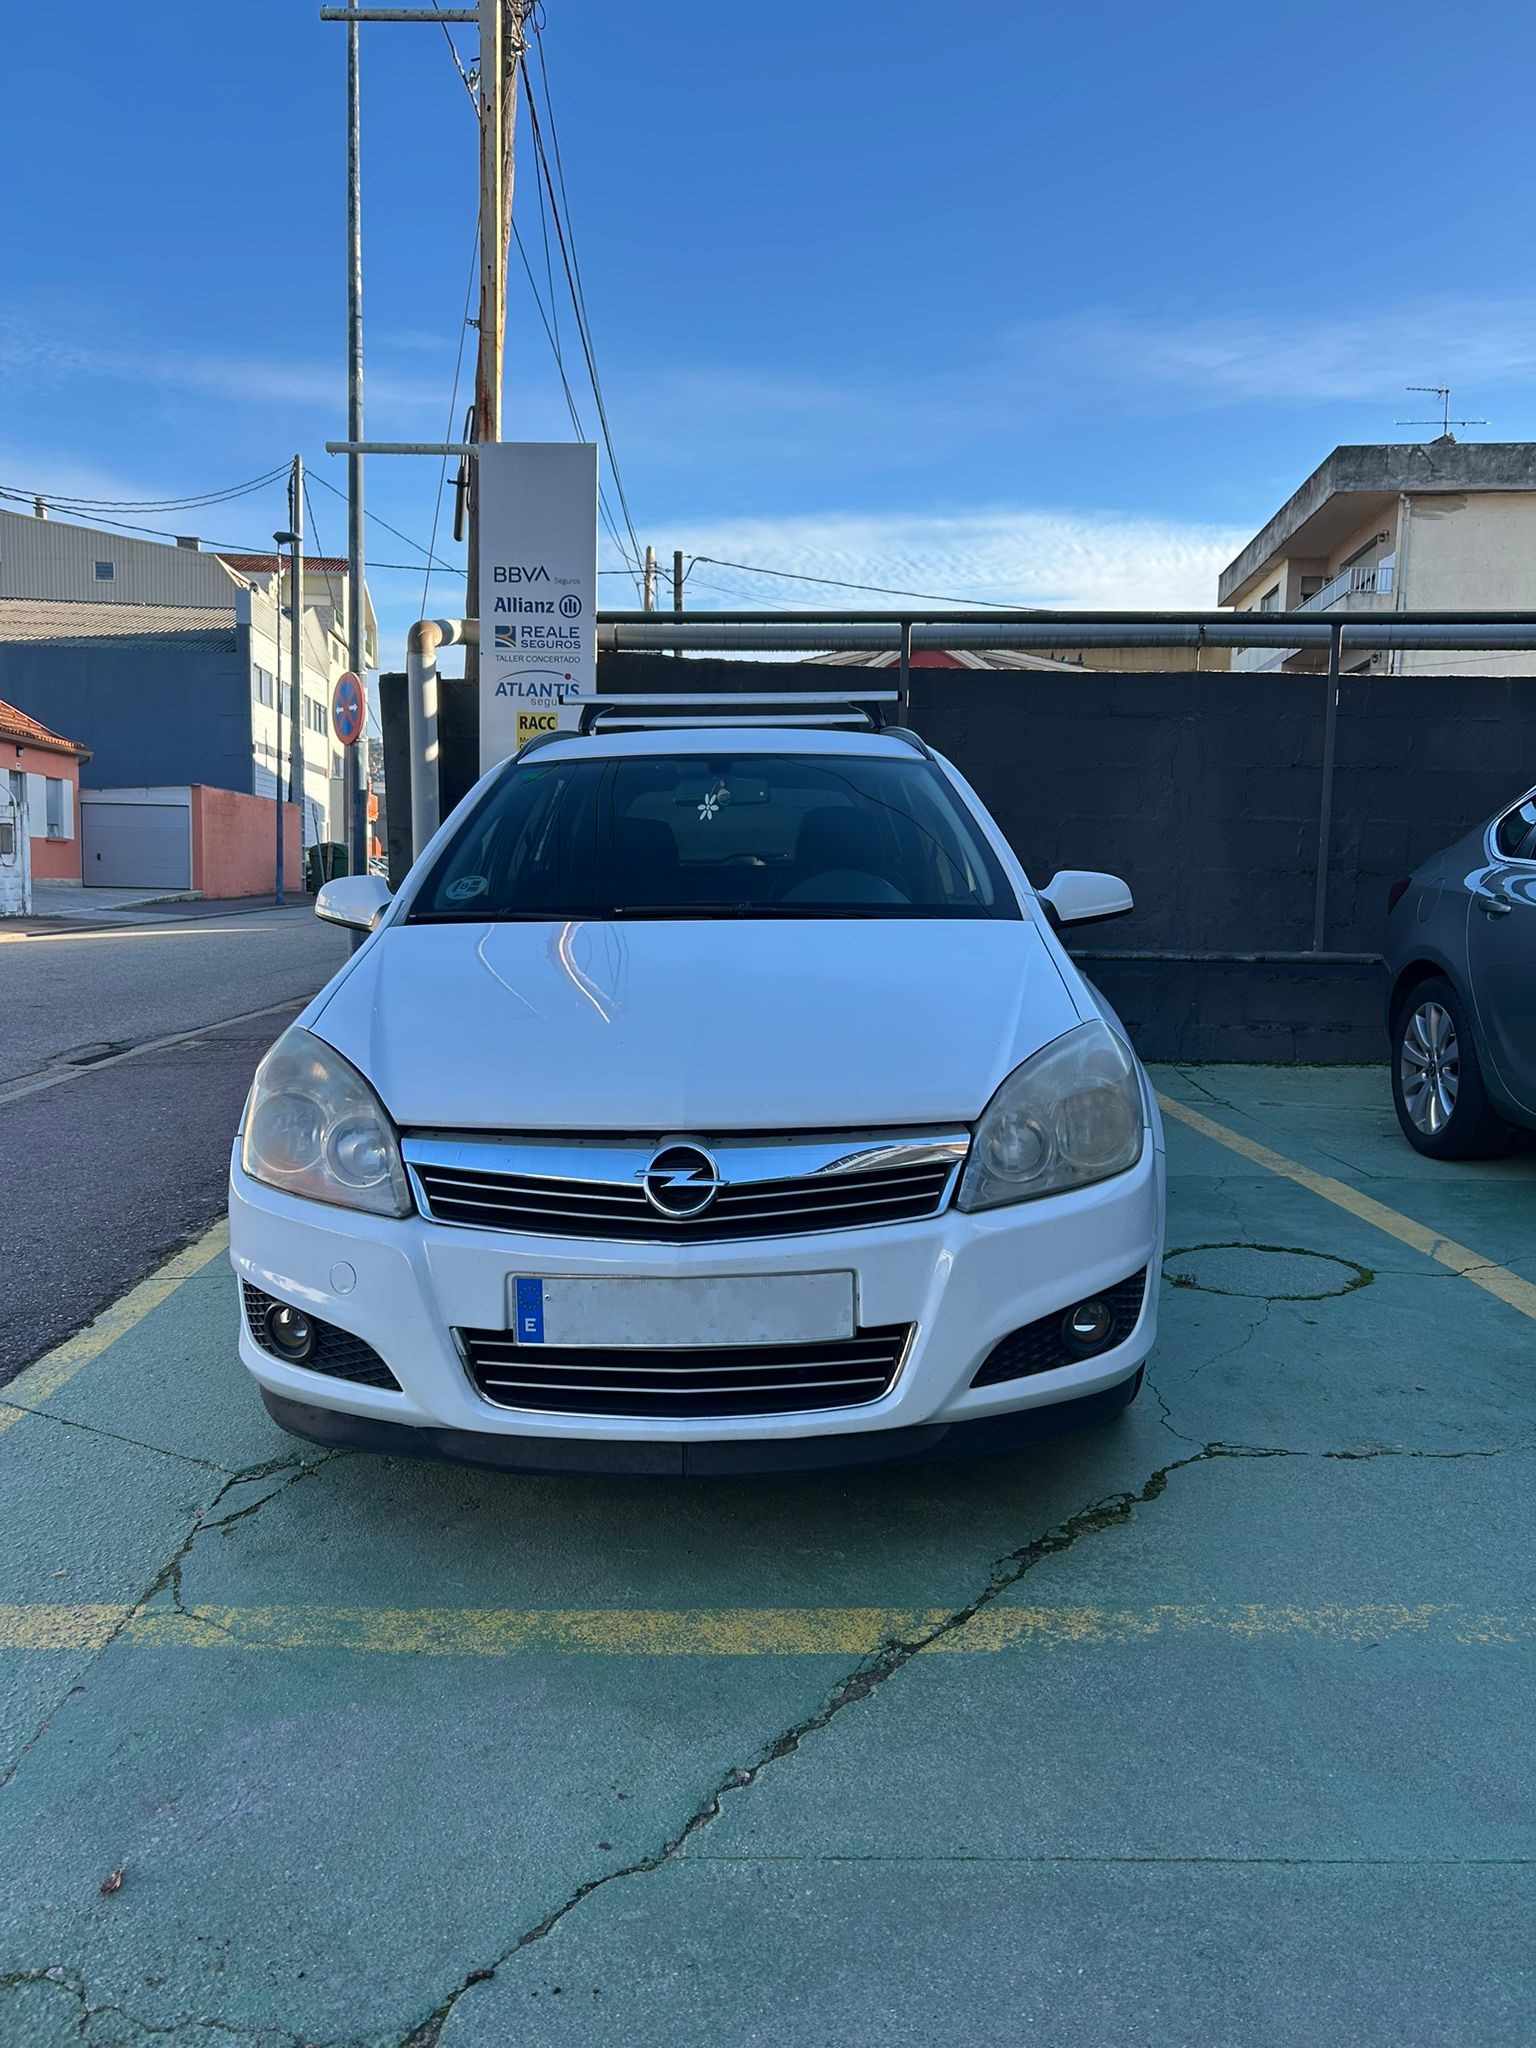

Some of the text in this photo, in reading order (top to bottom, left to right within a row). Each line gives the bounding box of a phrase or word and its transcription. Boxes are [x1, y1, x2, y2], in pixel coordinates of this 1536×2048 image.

[494, 565, 581, 586] BBVA Seguros
[494, 596, 555, 613] Allianz
[521, 625, 580, 639] REALE
[520, 639, 581, 649] SEGUROS
[495, 654, 581, 664] TALLER CONCERTADO
[495, 682, 580, 697] ATLANTIS
[519, 715, 556, 730] RACC
[524, 1318, 537, 1332] E
